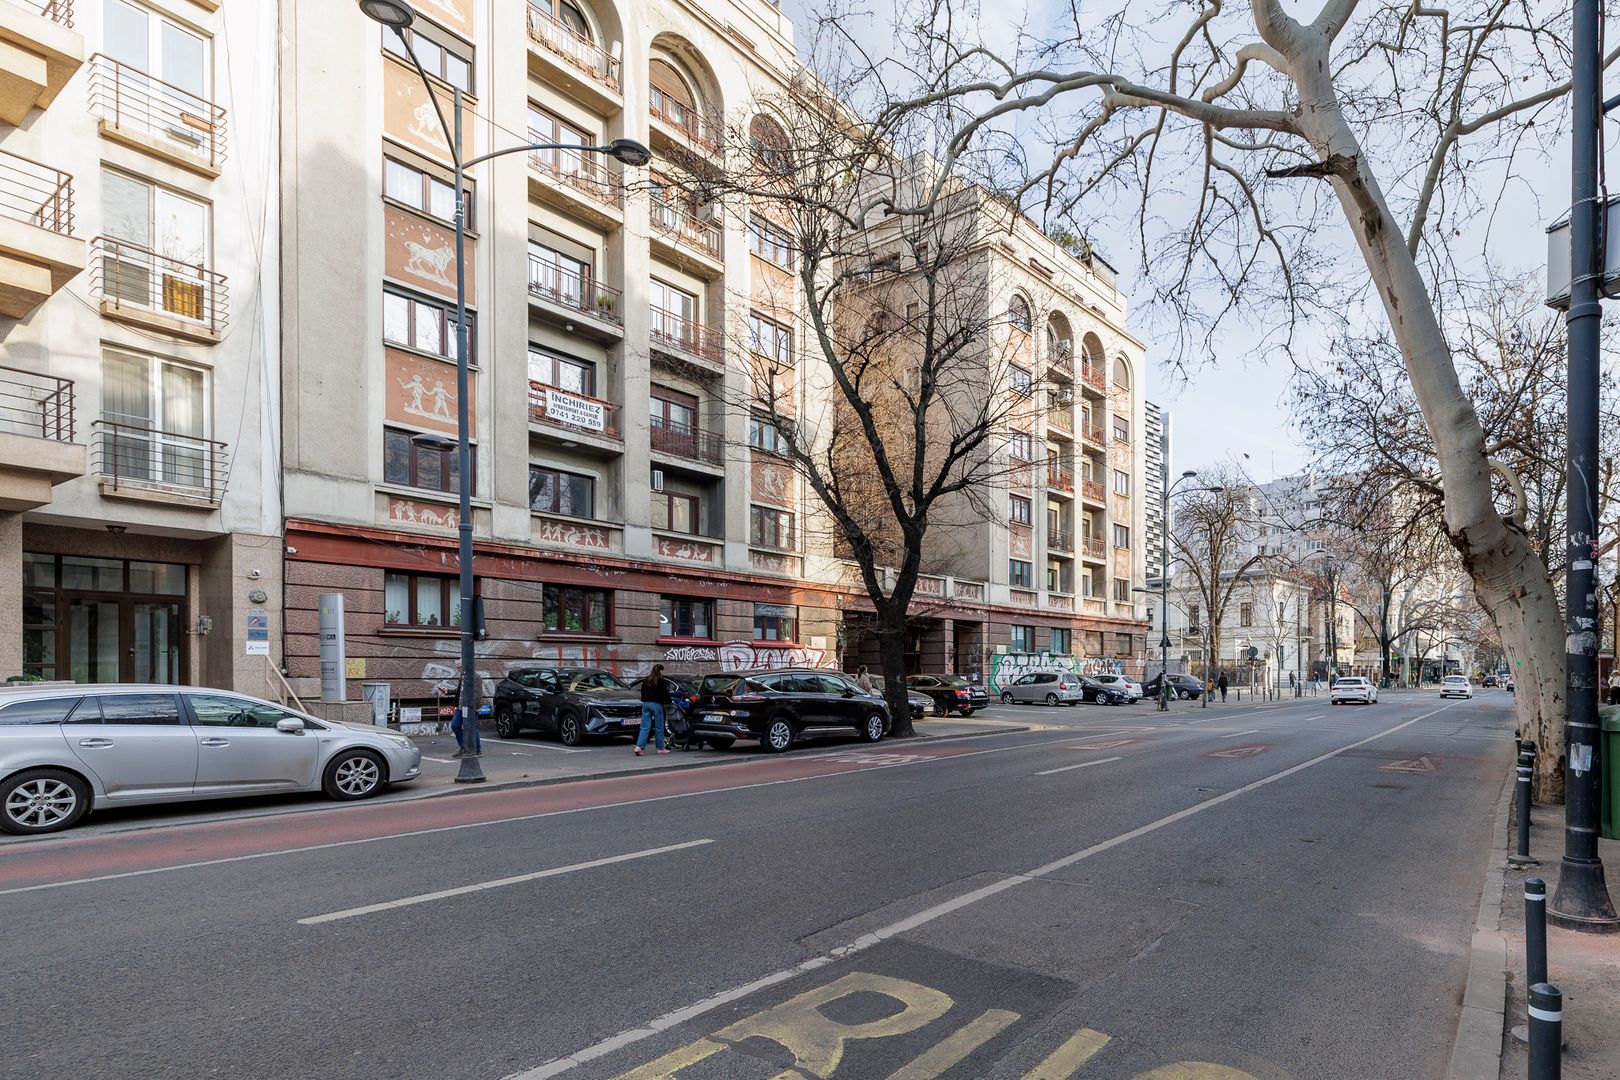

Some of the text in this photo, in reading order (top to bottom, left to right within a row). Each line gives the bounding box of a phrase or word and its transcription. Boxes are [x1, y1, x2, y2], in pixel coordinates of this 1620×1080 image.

[550, 407, 601, 428] 0741 220 559
